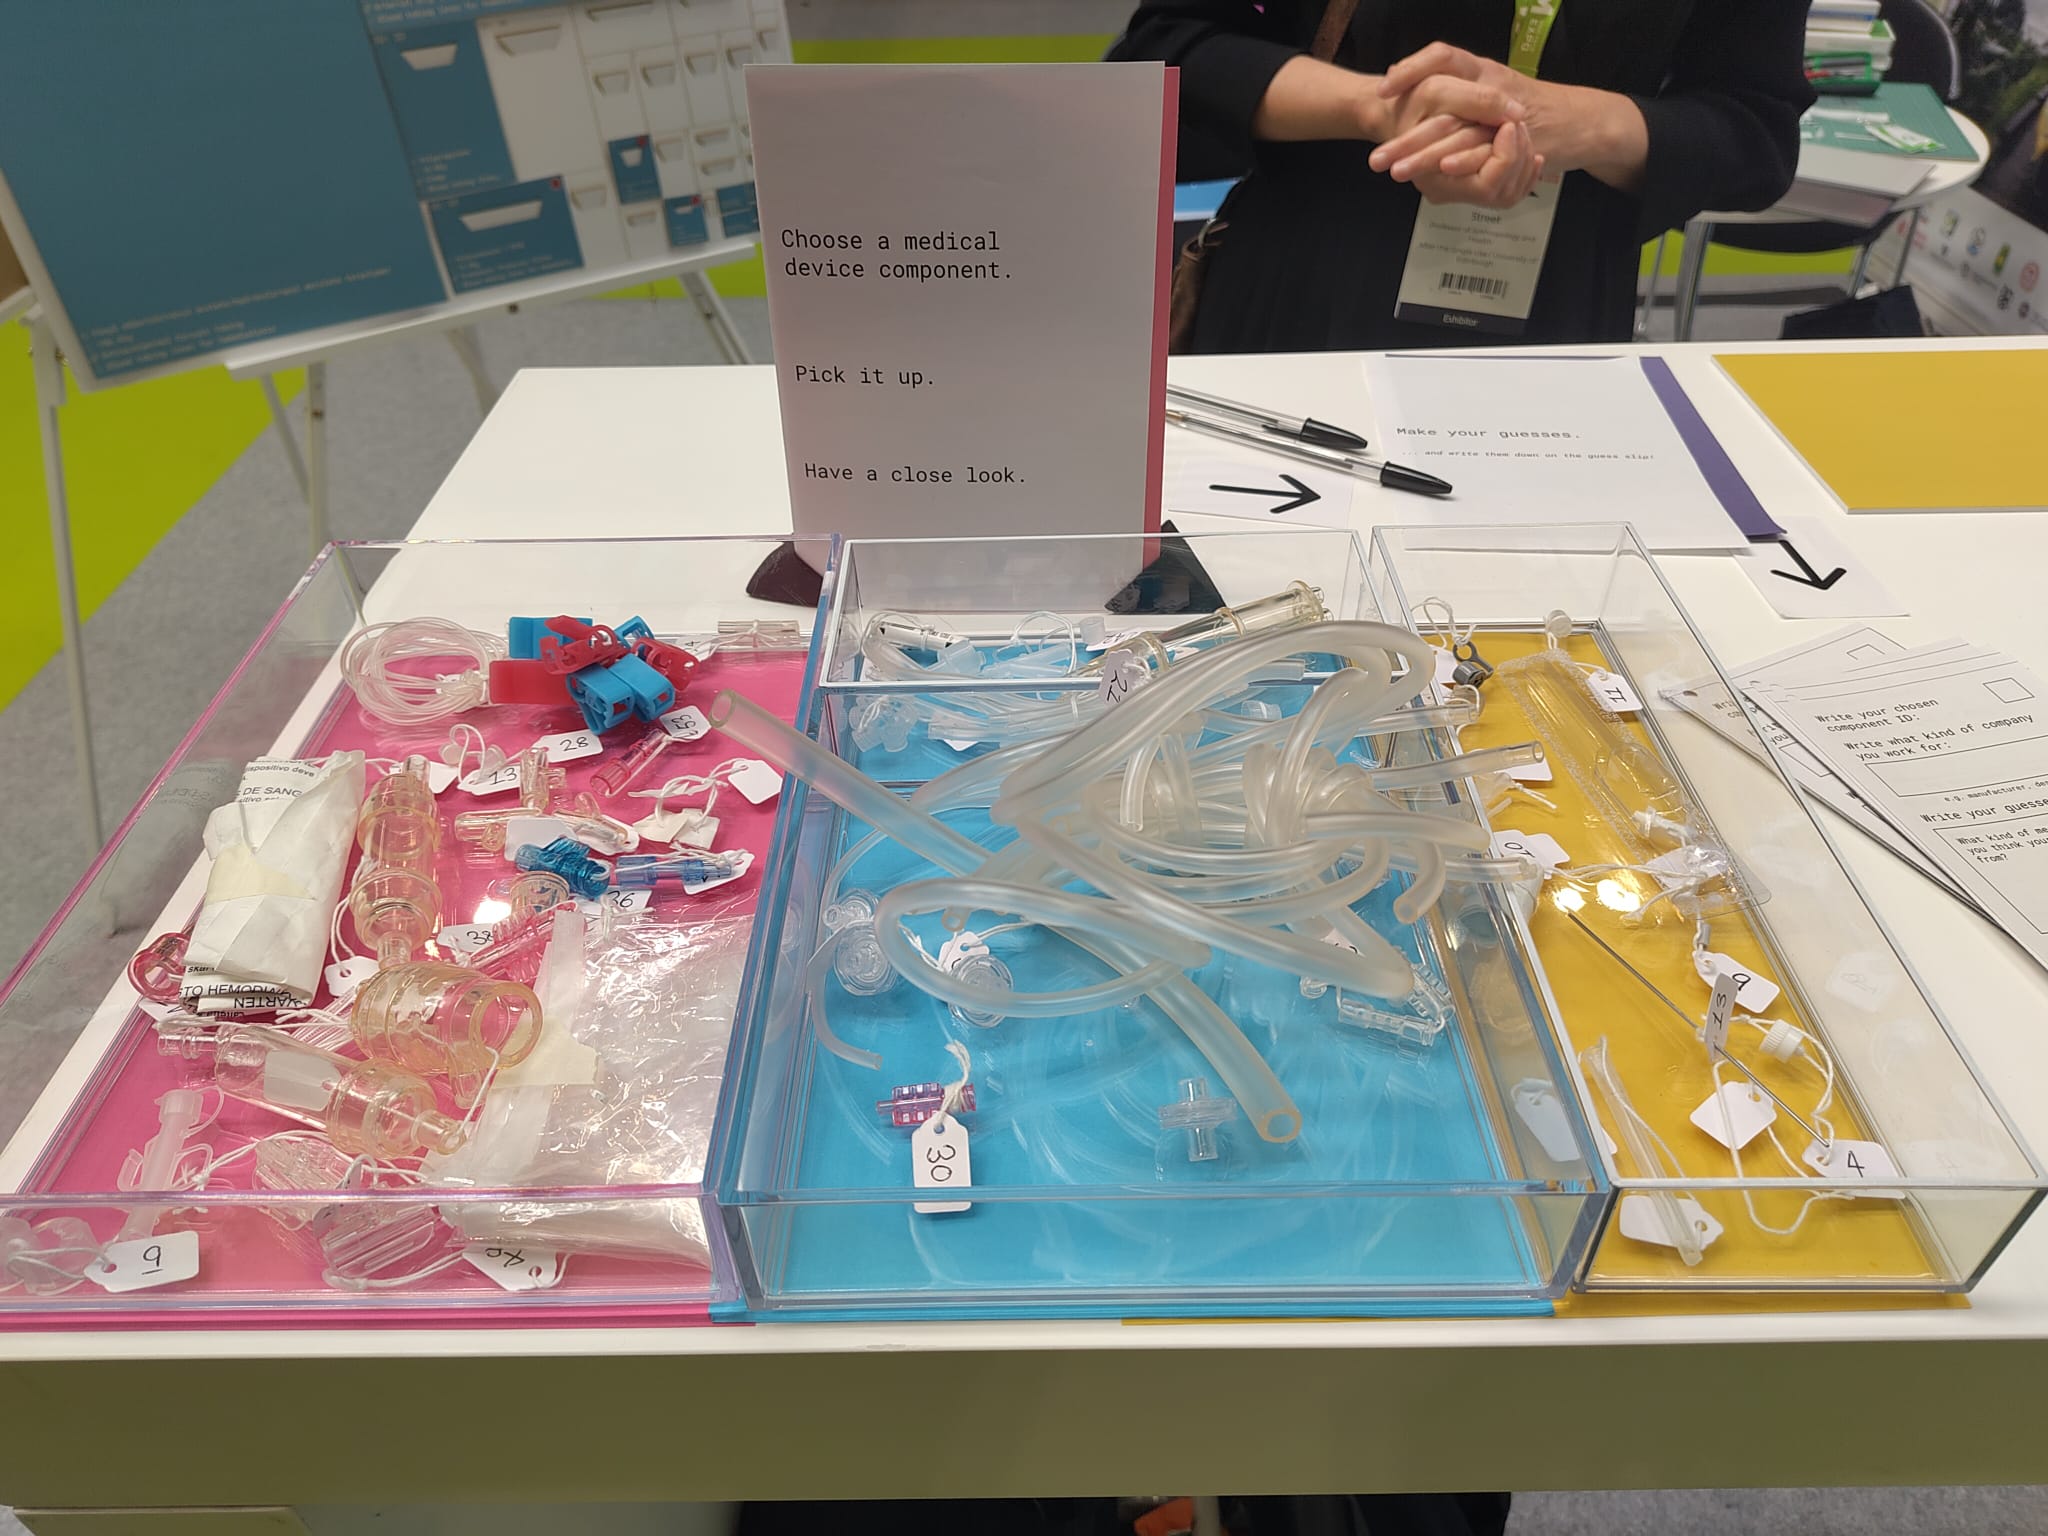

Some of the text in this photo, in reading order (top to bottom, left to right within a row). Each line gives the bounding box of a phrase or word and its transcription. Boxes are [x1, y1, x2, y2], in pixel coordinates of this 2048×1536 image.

[781, 228, 1001, 251] Choose a medical
[785, 258, 1013, 283] device component.
[795, 364, 935, 388] Pick it up.
[1396, 427, 1582, 440] Make your guesses.
[804, 462, 1027, 484] Have a close look.
[1815, 698, 1939, 723] Write your chosen
[674, 713, 698, 731] 53
[1826, 712, 1920, 733] component ID:
[1844, 713, 2034, 751] Write what kind of company
[559, 736, 590, 752] 28
[1856, 742, 1951, 761] you work for:
[292, 766, 315, 778] deve
[489, 767, 517, 786] 13
[243, 786, 262, 796] DE
[1920, 811, 1962, 823] Write
[1966, 806, 1997, 820] your
[1955, 835, 1985, 846] What
[1986, 831, 2013, 842] kind
[2017, 828, 2030, 837] of
[1967, 846, 1988, 856] you
[1990, 840, 2024, 851] think
[1976, 852, 2008, 864] from?
[926, 1143, 956, 1182] 30
[1847, 1150, 1865, 1178] 4
